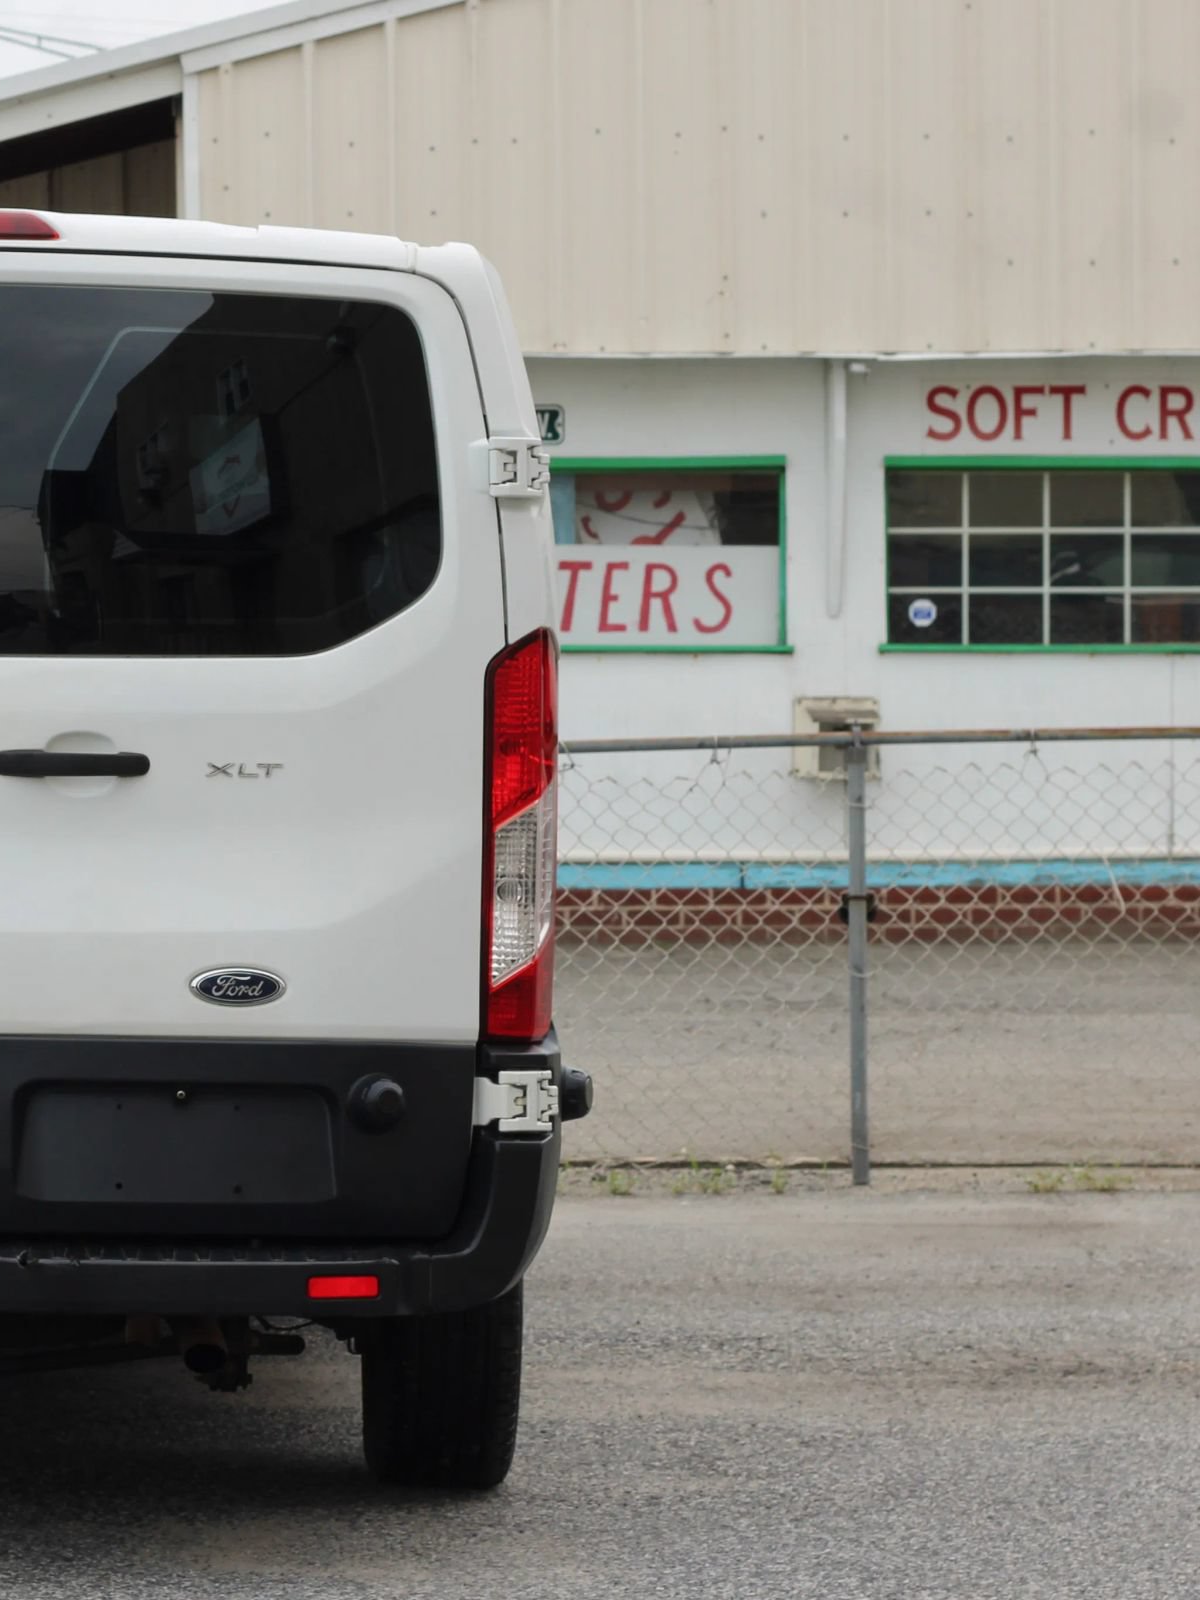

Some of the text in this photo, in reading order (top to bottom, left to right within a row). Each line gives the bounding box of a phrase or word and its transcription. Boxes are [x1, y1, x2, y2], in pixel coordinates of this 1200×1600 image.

[925, 384, 1195, 441] SOFT CR
[557, 560, 733, 634] TERS
[205, 762, 285, 778] XLT
[211, 975, 264, 997] Ford
